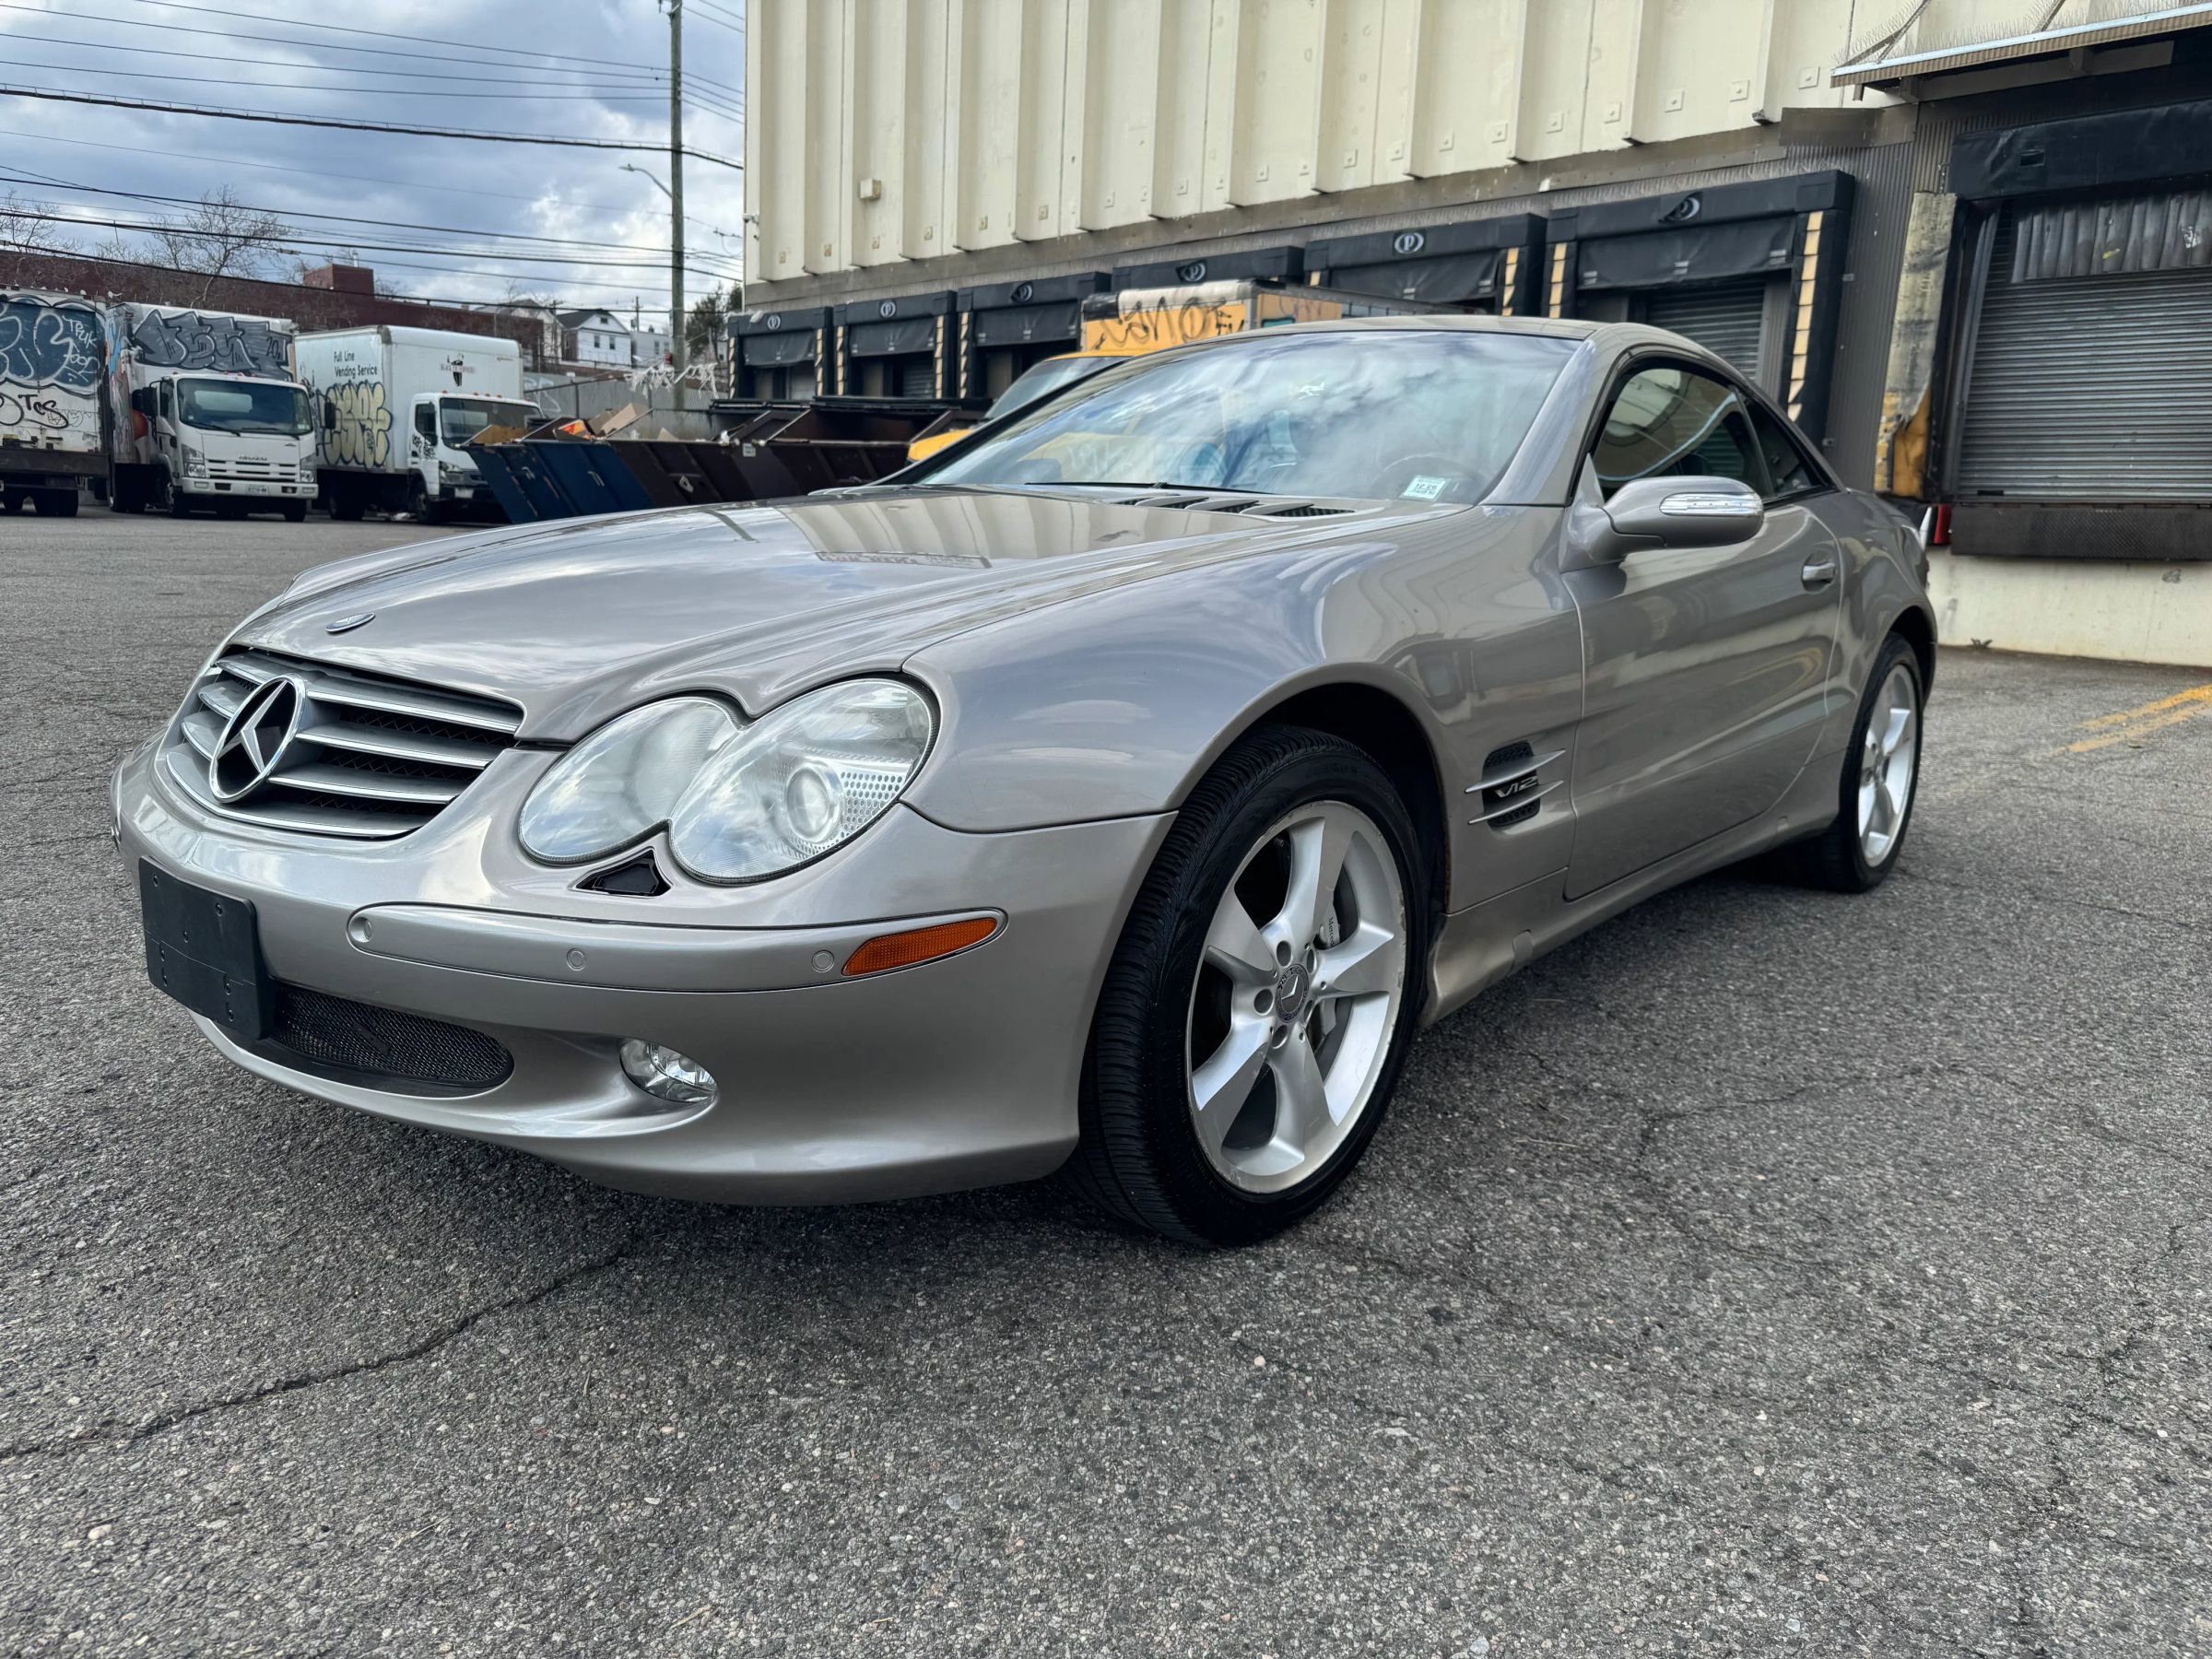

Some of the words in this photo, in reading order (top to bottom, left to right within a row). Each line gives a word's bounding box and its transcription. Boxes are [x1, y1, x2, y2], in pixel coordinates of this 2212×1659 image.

[334, 351, 342, 362] Full
[344, 350, 355, 361] Line
[335, 365, 356, 379] Vending
[358, 364, 377, 376] Service
[1496, 776, 1538, 798] V12
